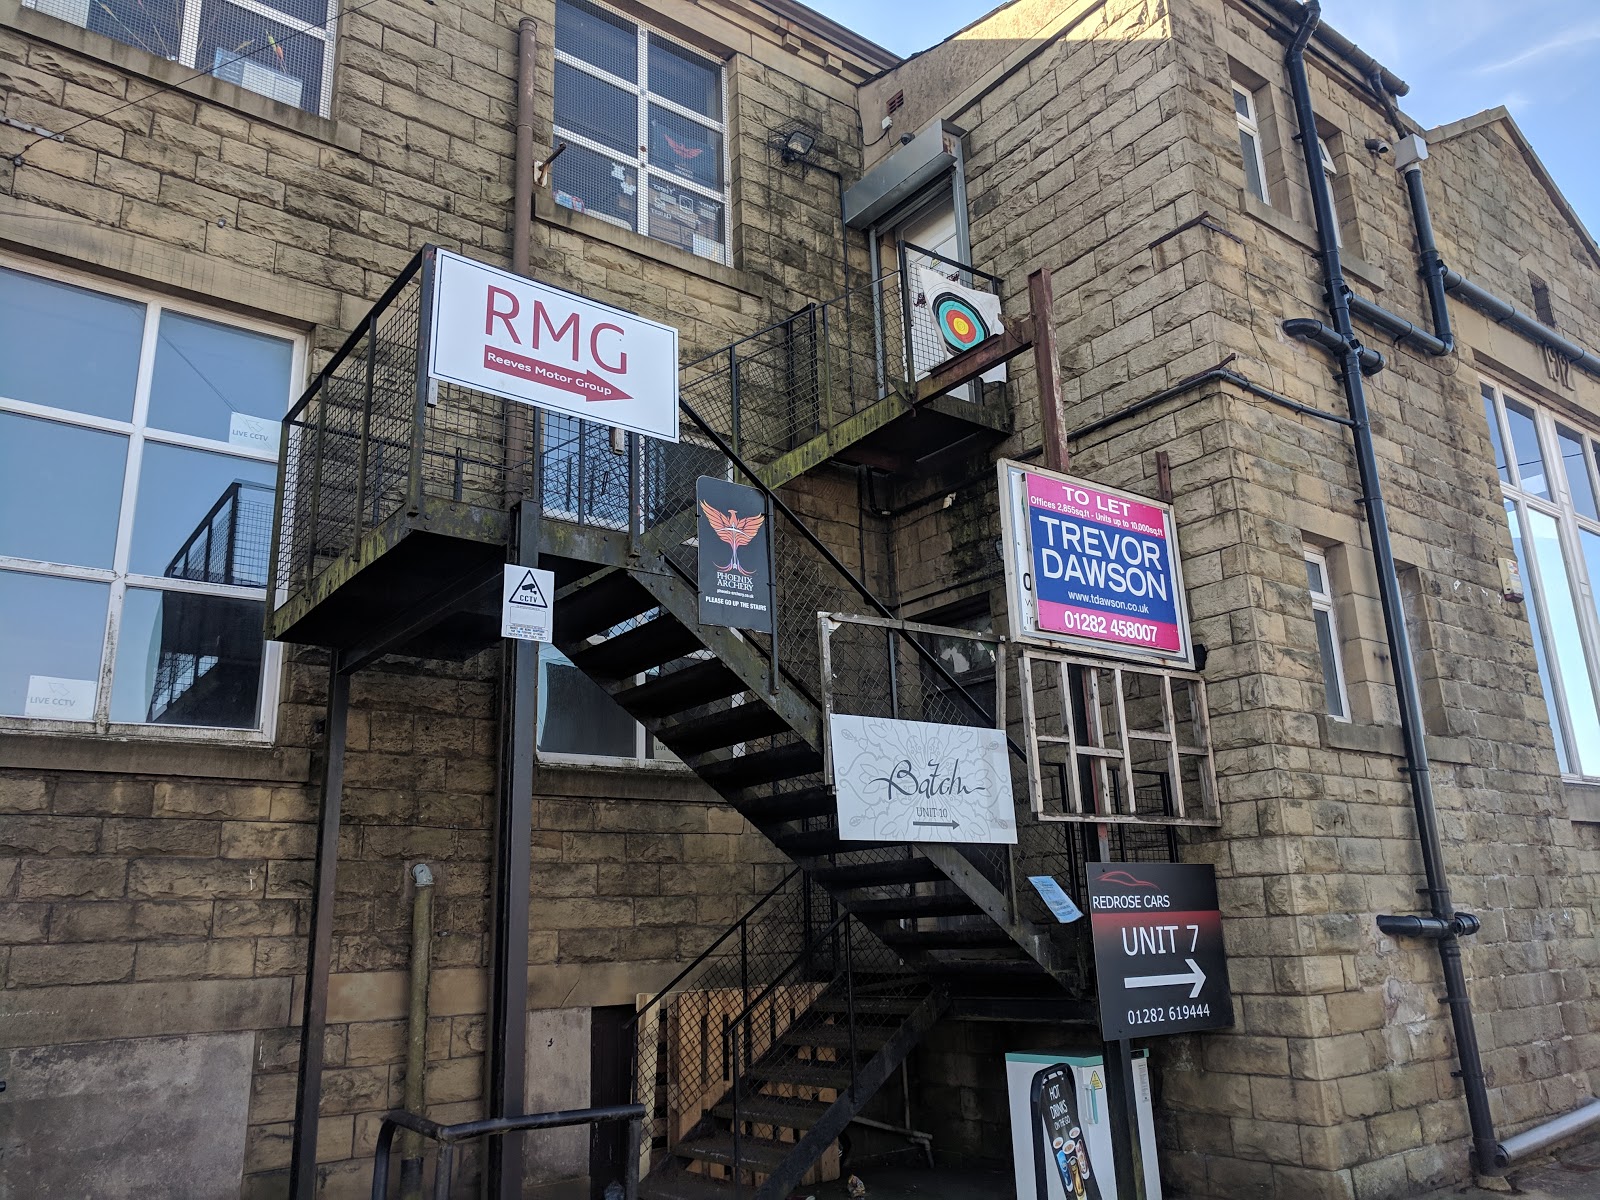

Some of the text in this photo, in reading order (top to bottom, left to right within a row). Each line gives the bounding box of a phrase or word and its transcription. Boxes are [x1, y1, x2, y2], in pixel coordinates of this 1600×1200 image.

[485, 284, 627, 374] RMG
[487, 352, 612, 396] Reeves Motor Group
[232, 429, 269, 442] LIVE CCTV
[1030, 495, 1056, 510] Offices
[1095, 511, 1112, 525] Units
[1113, 518, 1122, 528] up
[1122, 518, 1130, 529] to
[1061, 485, 1131, 517] TO LET
[1038, 515, 1162, 571] TREVOR
[716, 571, 753, 585] PHOENIX
[716, 579, 754, 592] ARCHERY
[1041, 547, 1168, 602] DAWSON
[519, 594, 538, 603] CCTV
[705, 595, 724, 605] PLEASE
[739, 601, 749, 609] THE
[749, 602, 767, 611] STAIRS
[1067, 590, 1150, 614] www.tdawson.co.uk
[1064, 610, 1158, 643] 01282 458007
[29, 696, 76, 706] LIVE CCTV
[868, 758, 986, 801] Batch
[916, 806, 948, 818] UNIT 10
[1092, 894, 1171, 909] REDROSE CARS
[1121, 924, 1199, 956] UNIT 7
[1127, 1003, 1211, 1025] 01282 619444
[1048, 1084, 1061, 1101] HOT
[1049, 1099, 1069, 1120] DRINKS
